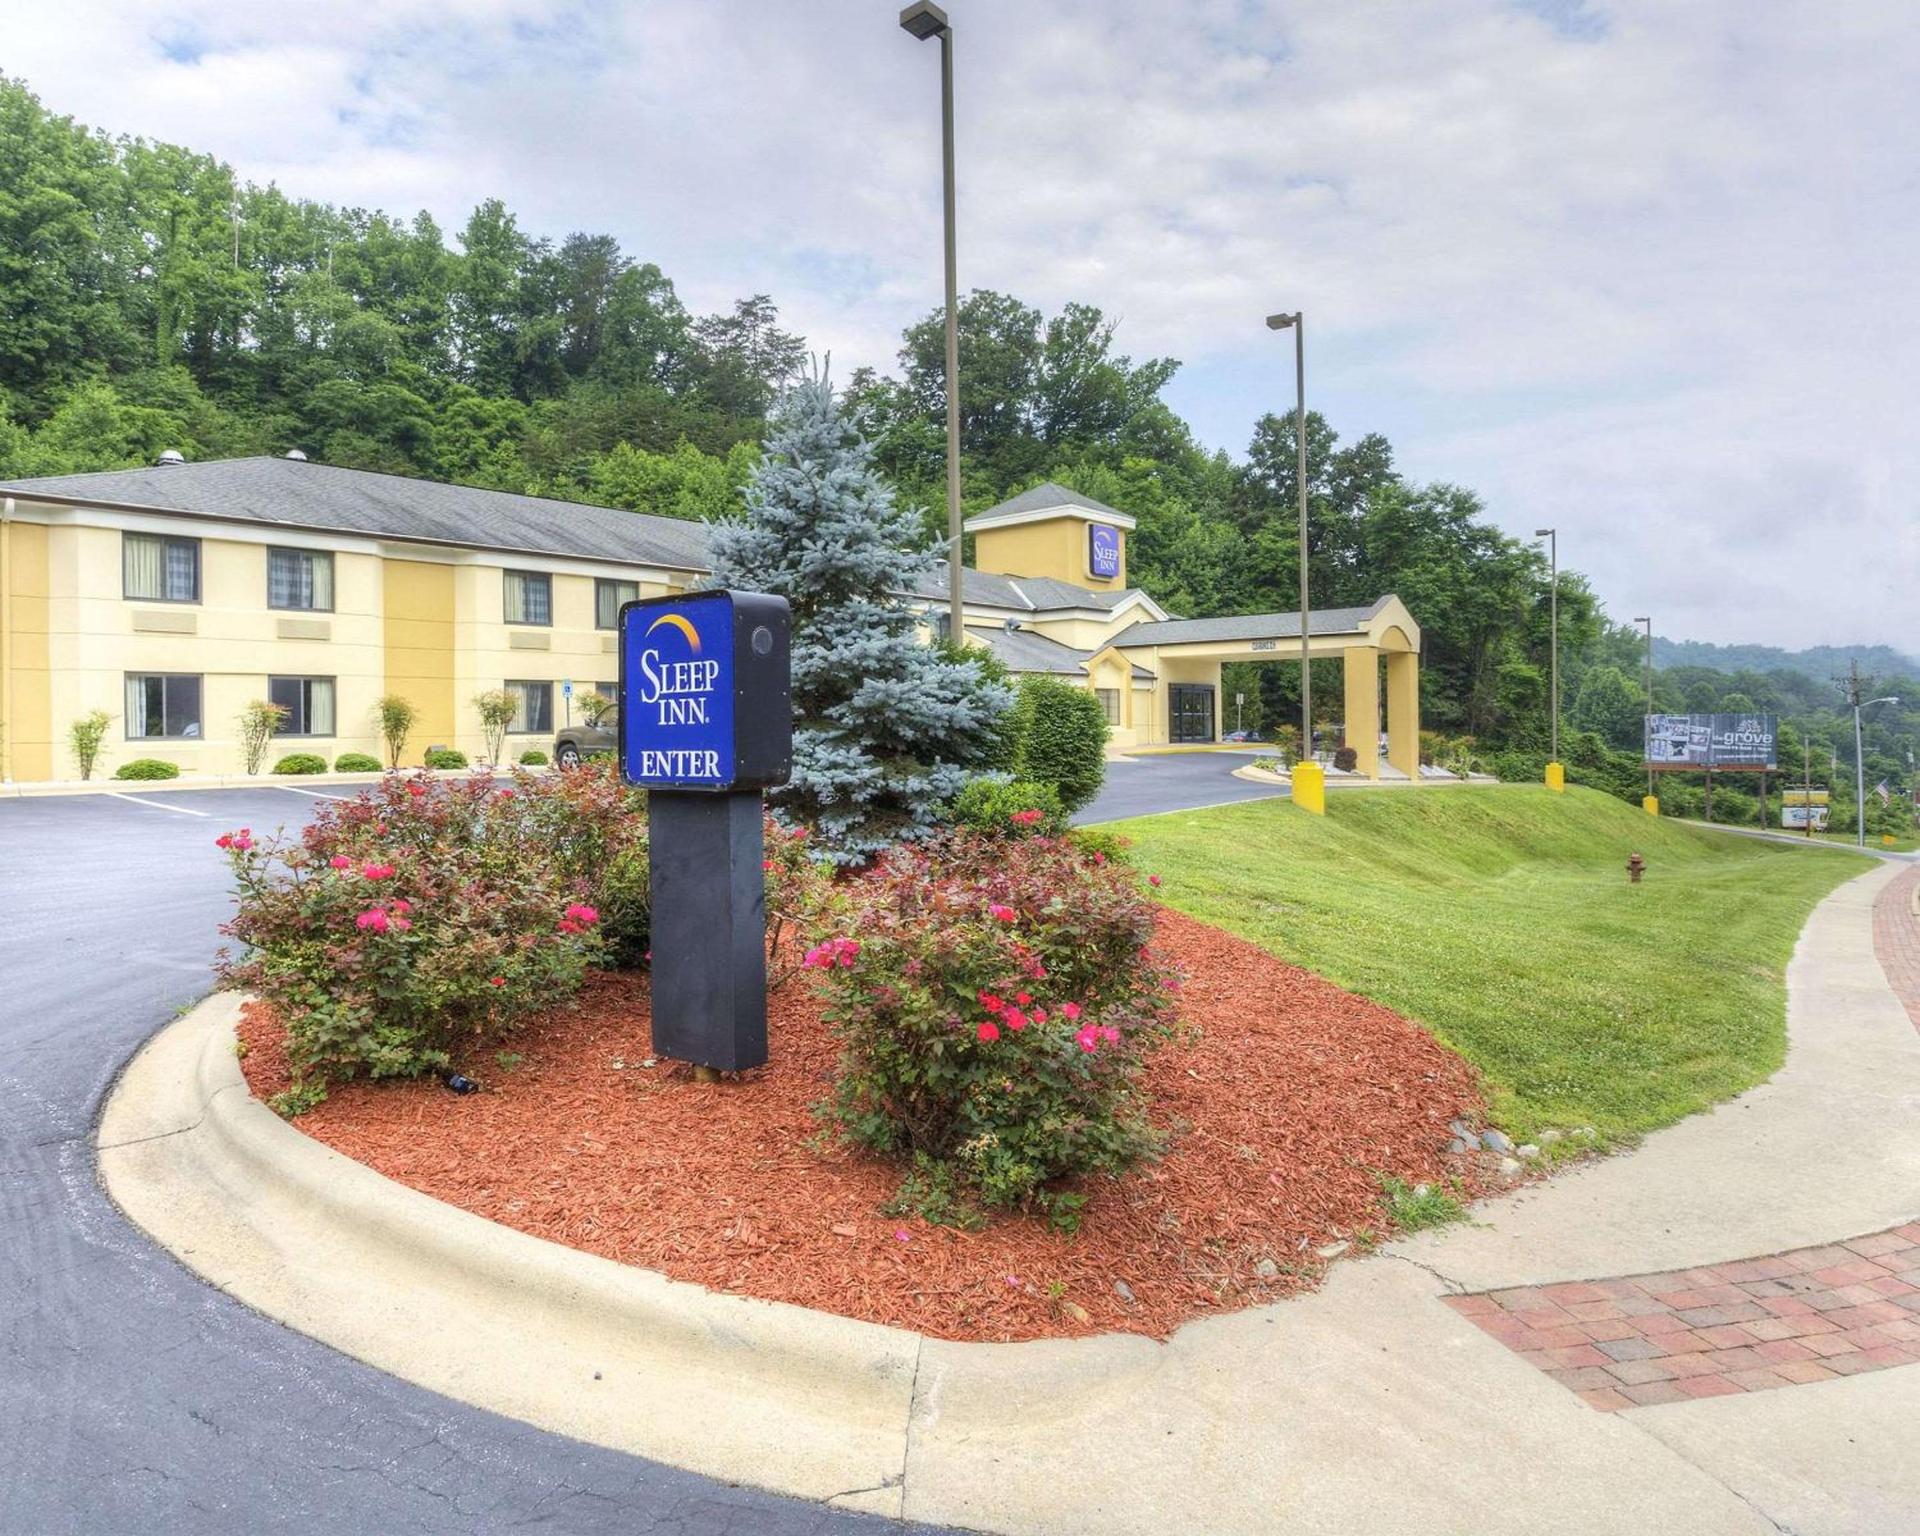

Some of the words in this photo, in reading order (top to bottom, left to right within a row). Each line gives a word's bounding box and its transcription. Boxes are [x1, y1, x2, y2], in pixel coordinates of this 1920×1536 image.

[1094, 541, 1118, 561] SLEEP
[1100, 560, 1115, 571] INN
[641, 649, 720, 703] SLEEP
[657, 698, 707, 726] INN
[1723, 731, 1773, 745] grove
[640, 750, 722, 778] ENTER
